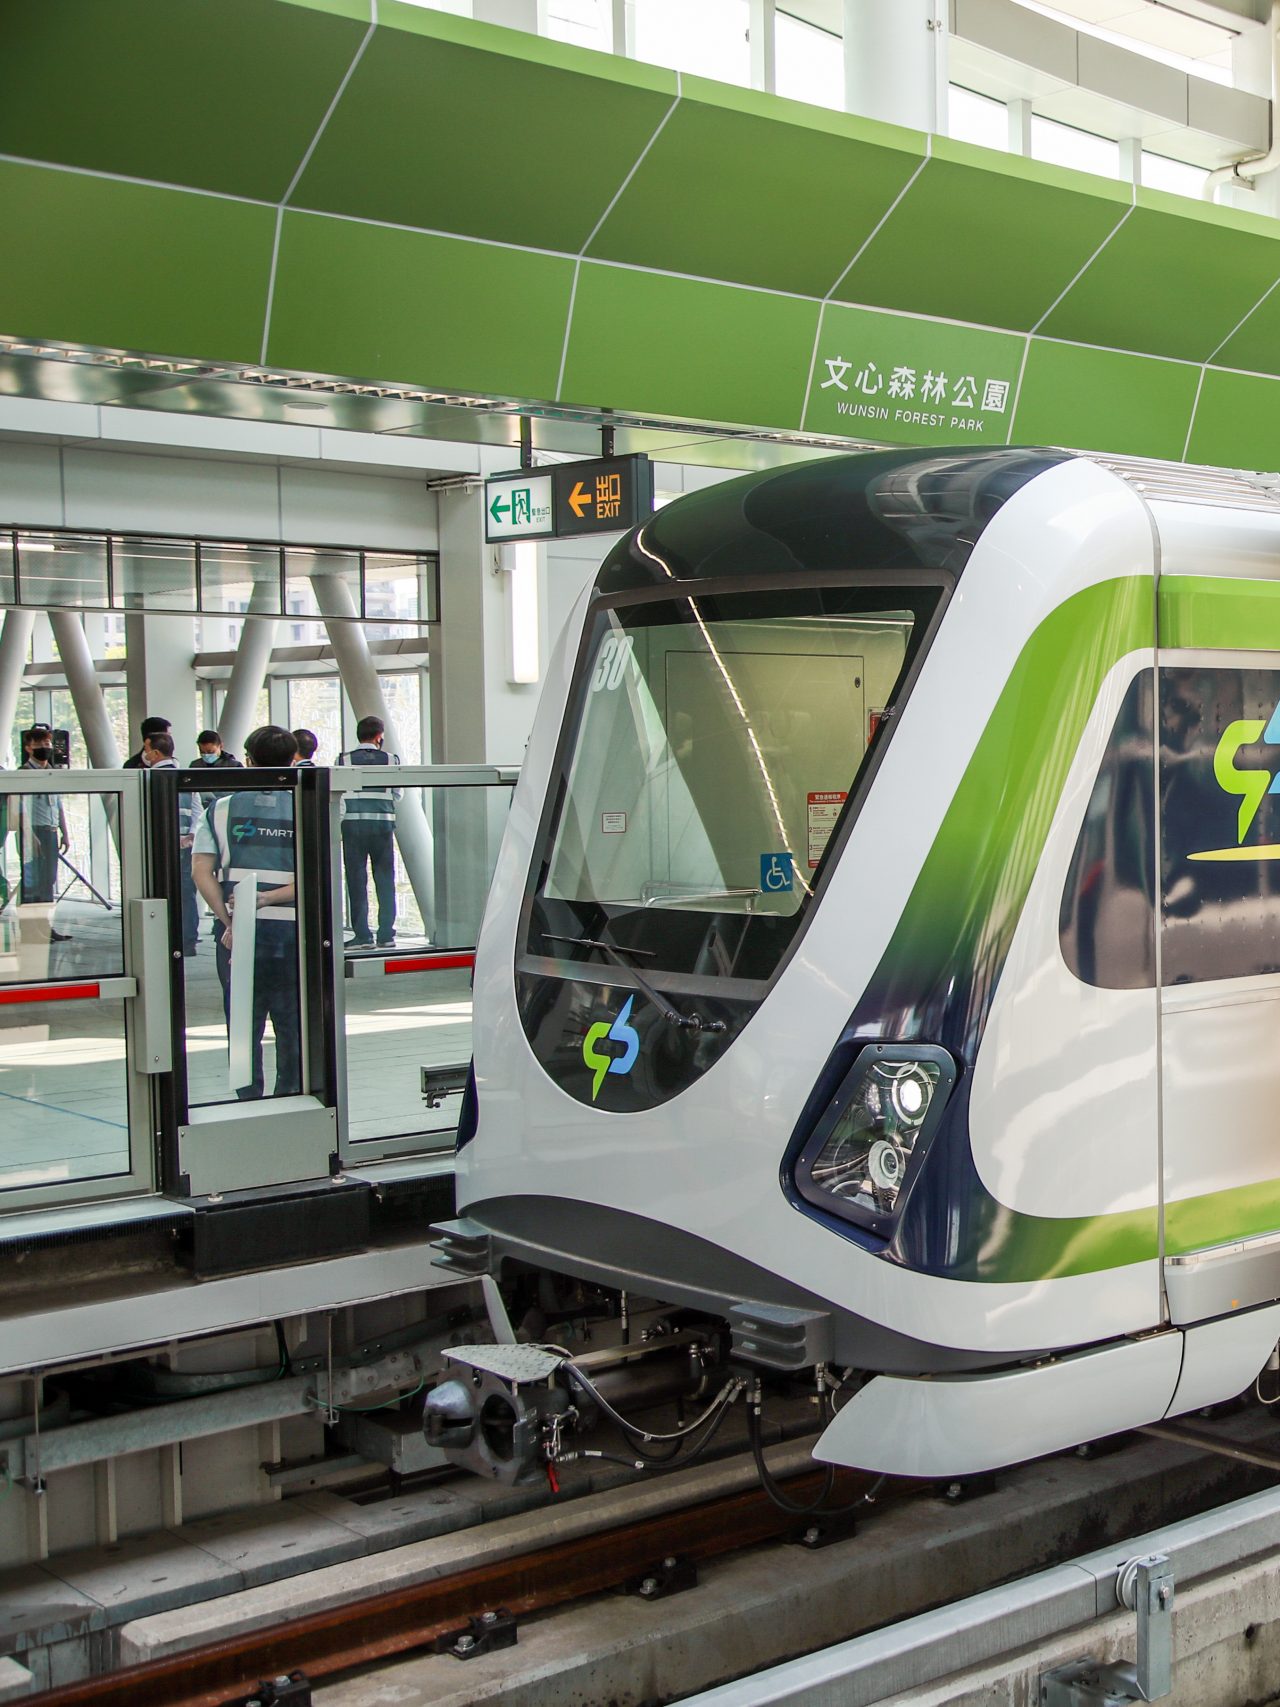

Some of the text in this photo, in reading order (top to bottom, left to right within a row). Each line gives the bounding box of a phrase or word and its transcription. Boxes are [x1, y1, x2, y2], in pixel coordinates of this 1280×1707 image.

[820, 355, 1010, 414] 文心森林公園
[837, 402, 984, 432] WUNSIN FOREST PARK
[596, 473, 621, 501] 出口
[596, 501, 621, 519] EXIT
[591, 636, 634, 692] 30
[257, 827, 294, 838] TMRT
